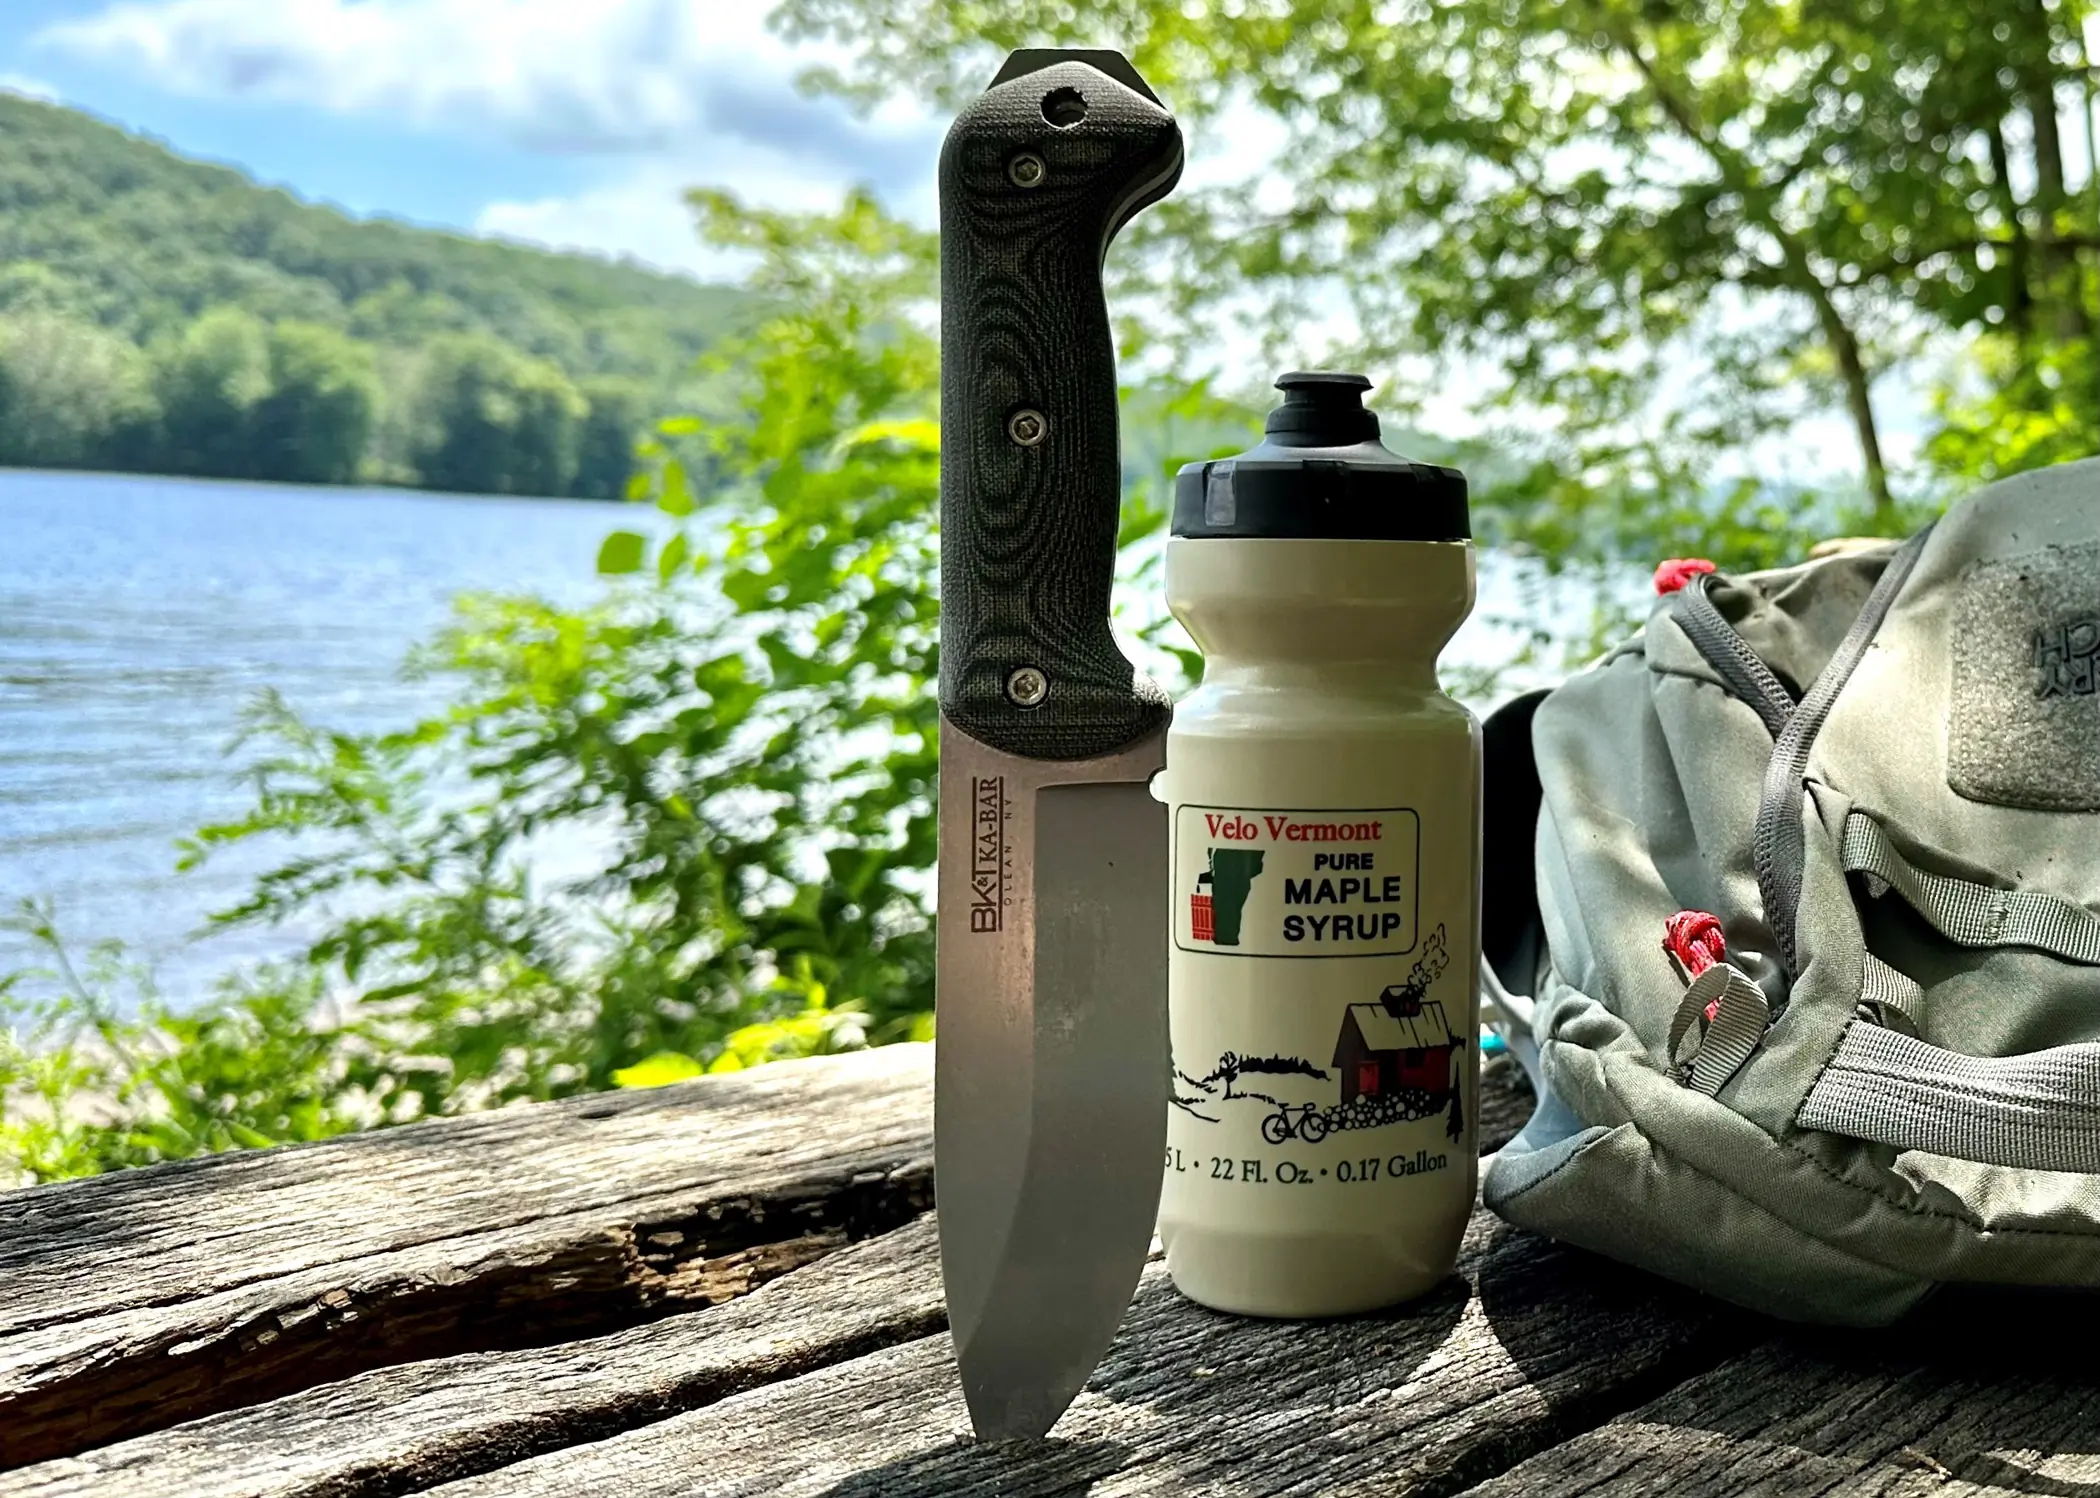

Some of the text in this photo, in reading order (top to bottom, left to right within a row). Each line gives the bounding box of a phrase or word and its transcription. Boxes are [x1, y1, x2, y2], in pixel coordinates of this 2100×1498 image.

[1004, 799, 1013, 820] NY
[1204, 813, 1382, 842] Velo Vermont
[970, 776, 998, 933] BK&T KA-BAR
[1314, 853, 1374, 871] PURE
[1284, 876, 1401, 904] MAPLE
[1283, 913, 1401, 942] SYRUP
[1175, 1149, 1186, 1172] L
[1210, 1157, 1235, 1180] 22
[1241, 1160, 1268, 1183] Fl.
[1275, 1162, 1314, 1184] Oz.
[1336, 1158, 1380, 1182] 0.17
[1387, 1149, 1448, 1178] Gallon
